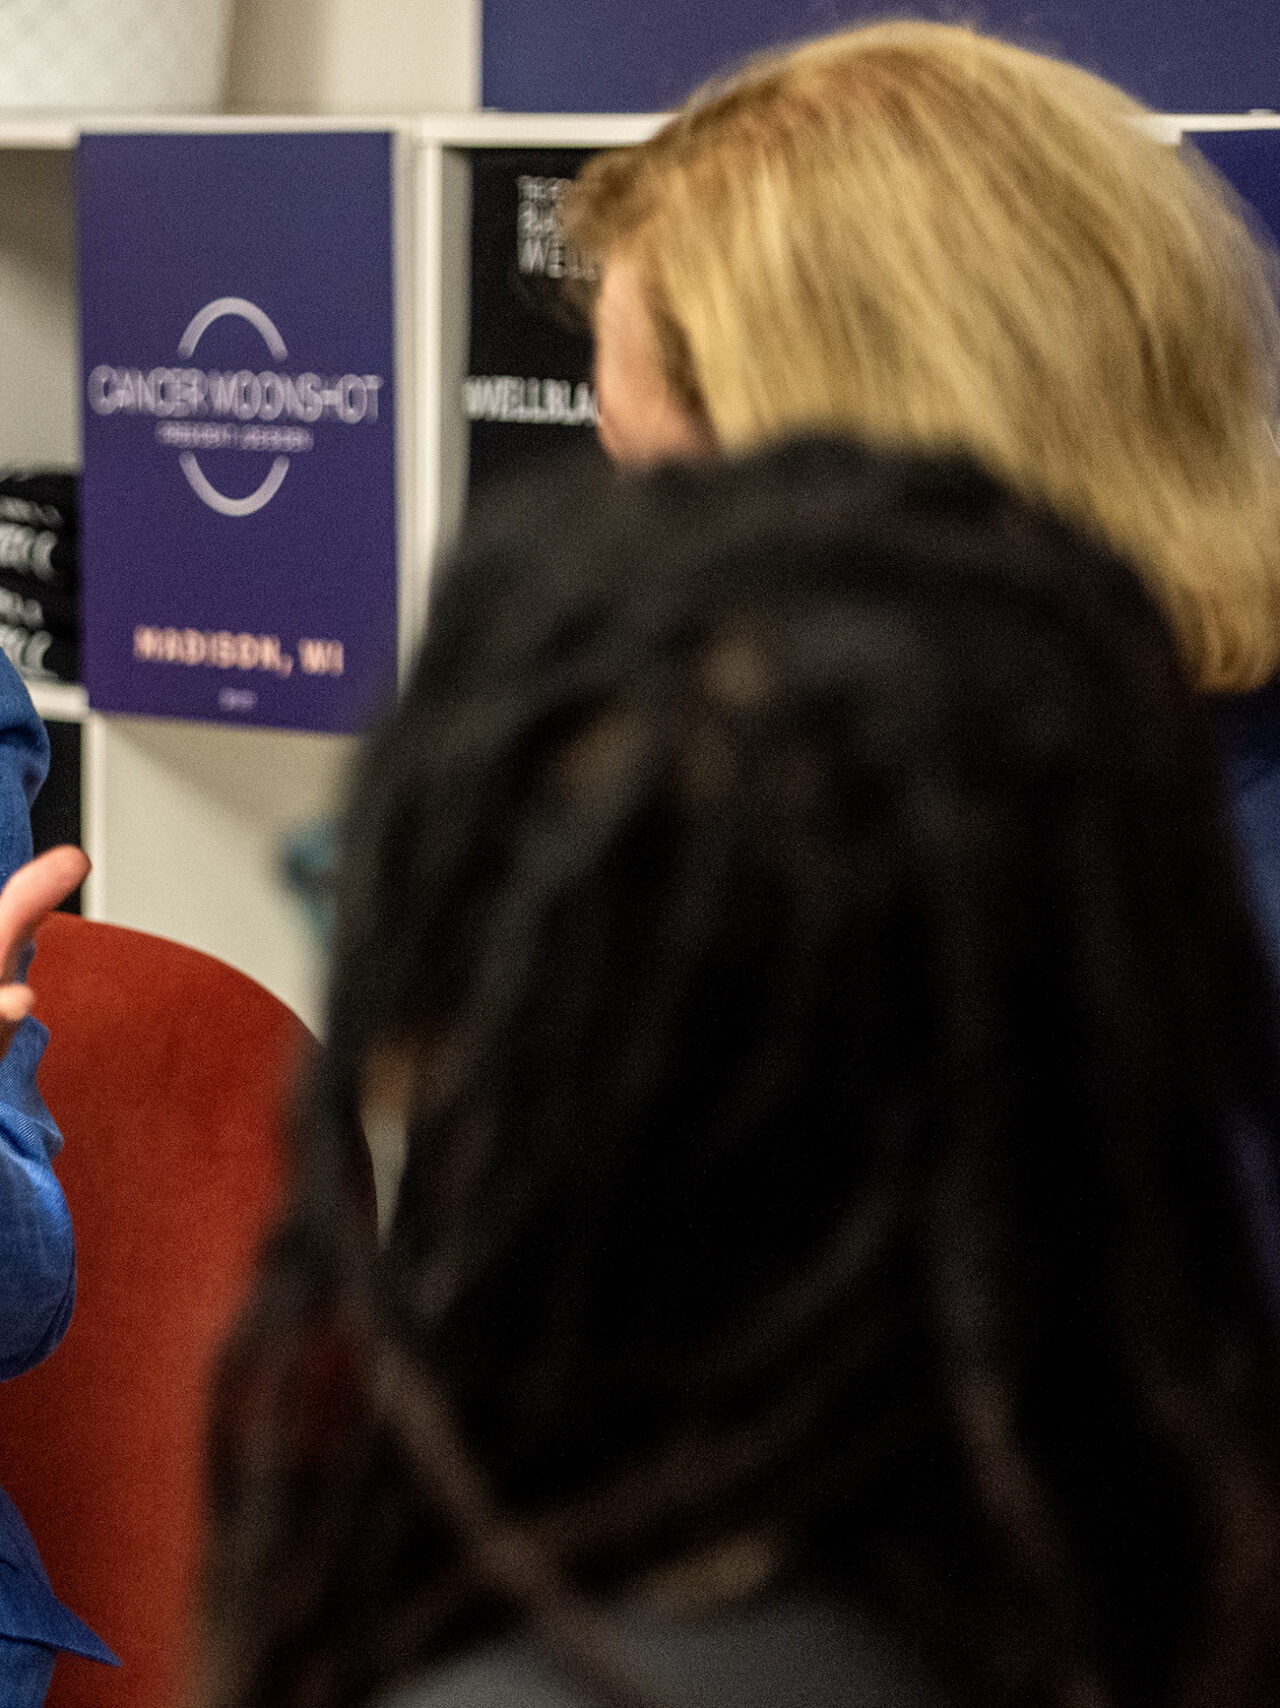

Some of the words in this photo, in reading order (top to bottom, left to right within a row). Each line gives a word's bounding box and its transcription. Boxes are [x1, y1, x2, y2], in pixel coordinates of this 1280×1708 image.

[88, 365, 207, 417] CANCER
[208, 369, 383, 424] MOONSHOT
[133, 625, 293, 678] MADISON,
[298, 638, 345, 677] WI
